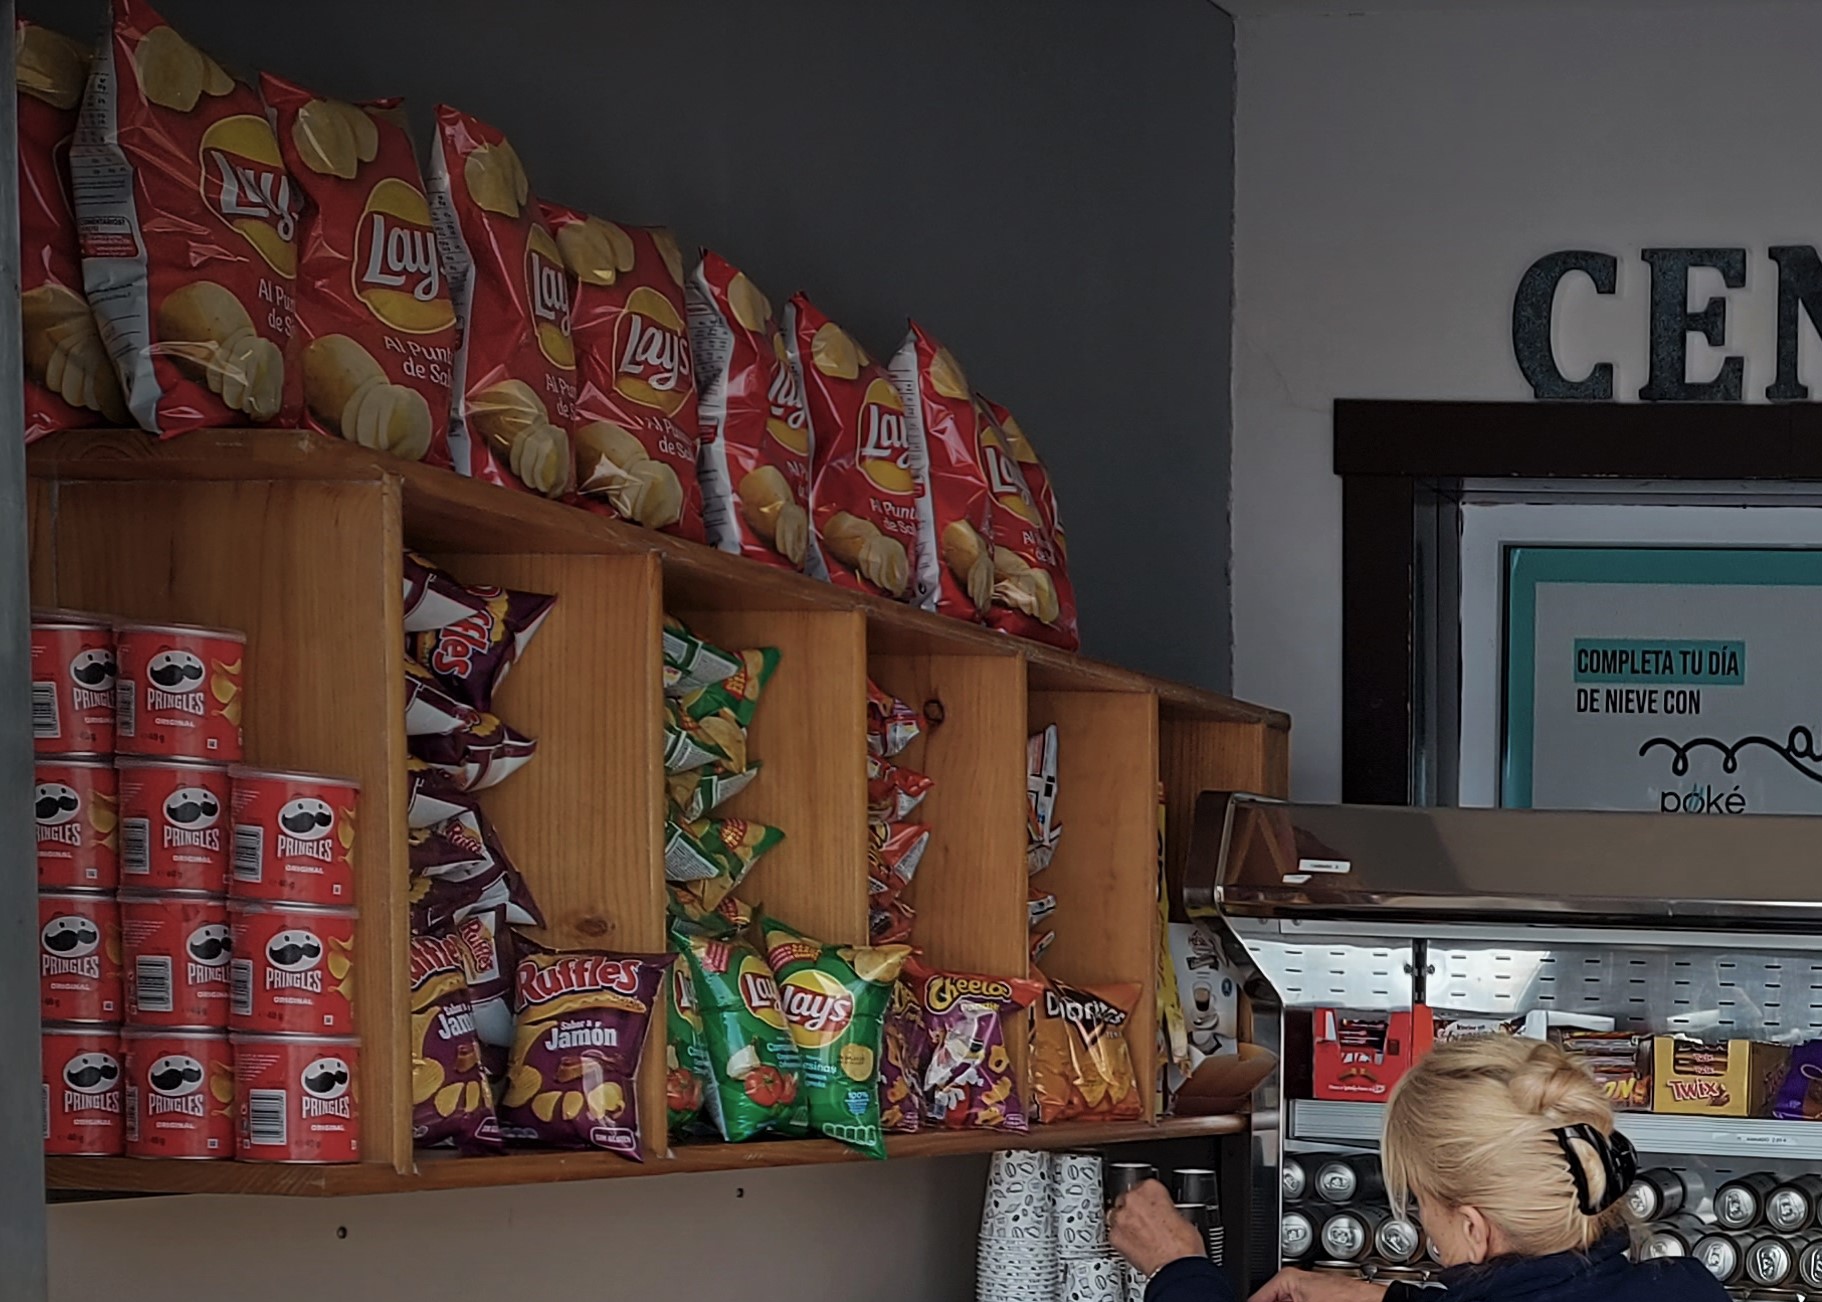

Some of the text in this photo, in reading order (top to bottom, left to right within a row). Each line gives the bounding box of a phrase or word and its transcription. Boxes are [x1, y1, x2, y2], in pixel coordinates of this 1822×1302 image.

[210, 150, 298, 242] Lay
[362, 213, 446, 301] Lay
[531, 252, 572, 337] Lay
[384, 335, 406, 354] Al
[402, 356, 426, 379] de
[861, 403, 911, 469] Lay
[1576, 641, 1739, 677] COMPLETA TU DÍA
[72, 686, 116, 711] PRINGL
[146, 686, 205, 716] PRINGLES
[1576, 688, 1701, 716] DE NIEVE CON
[1660, 783, 1747, 815] poké
[35, 822, 82, 847] RINGLES
[163, 824, 220, 852] PRINGLES
[277, 833, 333, 863] PRINGLES
[42, 953, 100, 979] PRINGLES
[187, 961, 231, 986] PRINGL
[265, 966, 322, 994] PRINGLES
[515, 955, 644, 1014] Ruffles
[438, 1011, 475, 1040] Jam
[545, 1022, 618, 1050] Jamón
[64, 1089, 121, 1114] PRINGLES
[148, 1092, 205, 1117] PRINGLES
[301, 1095, 351, 1119] PRINGLES
